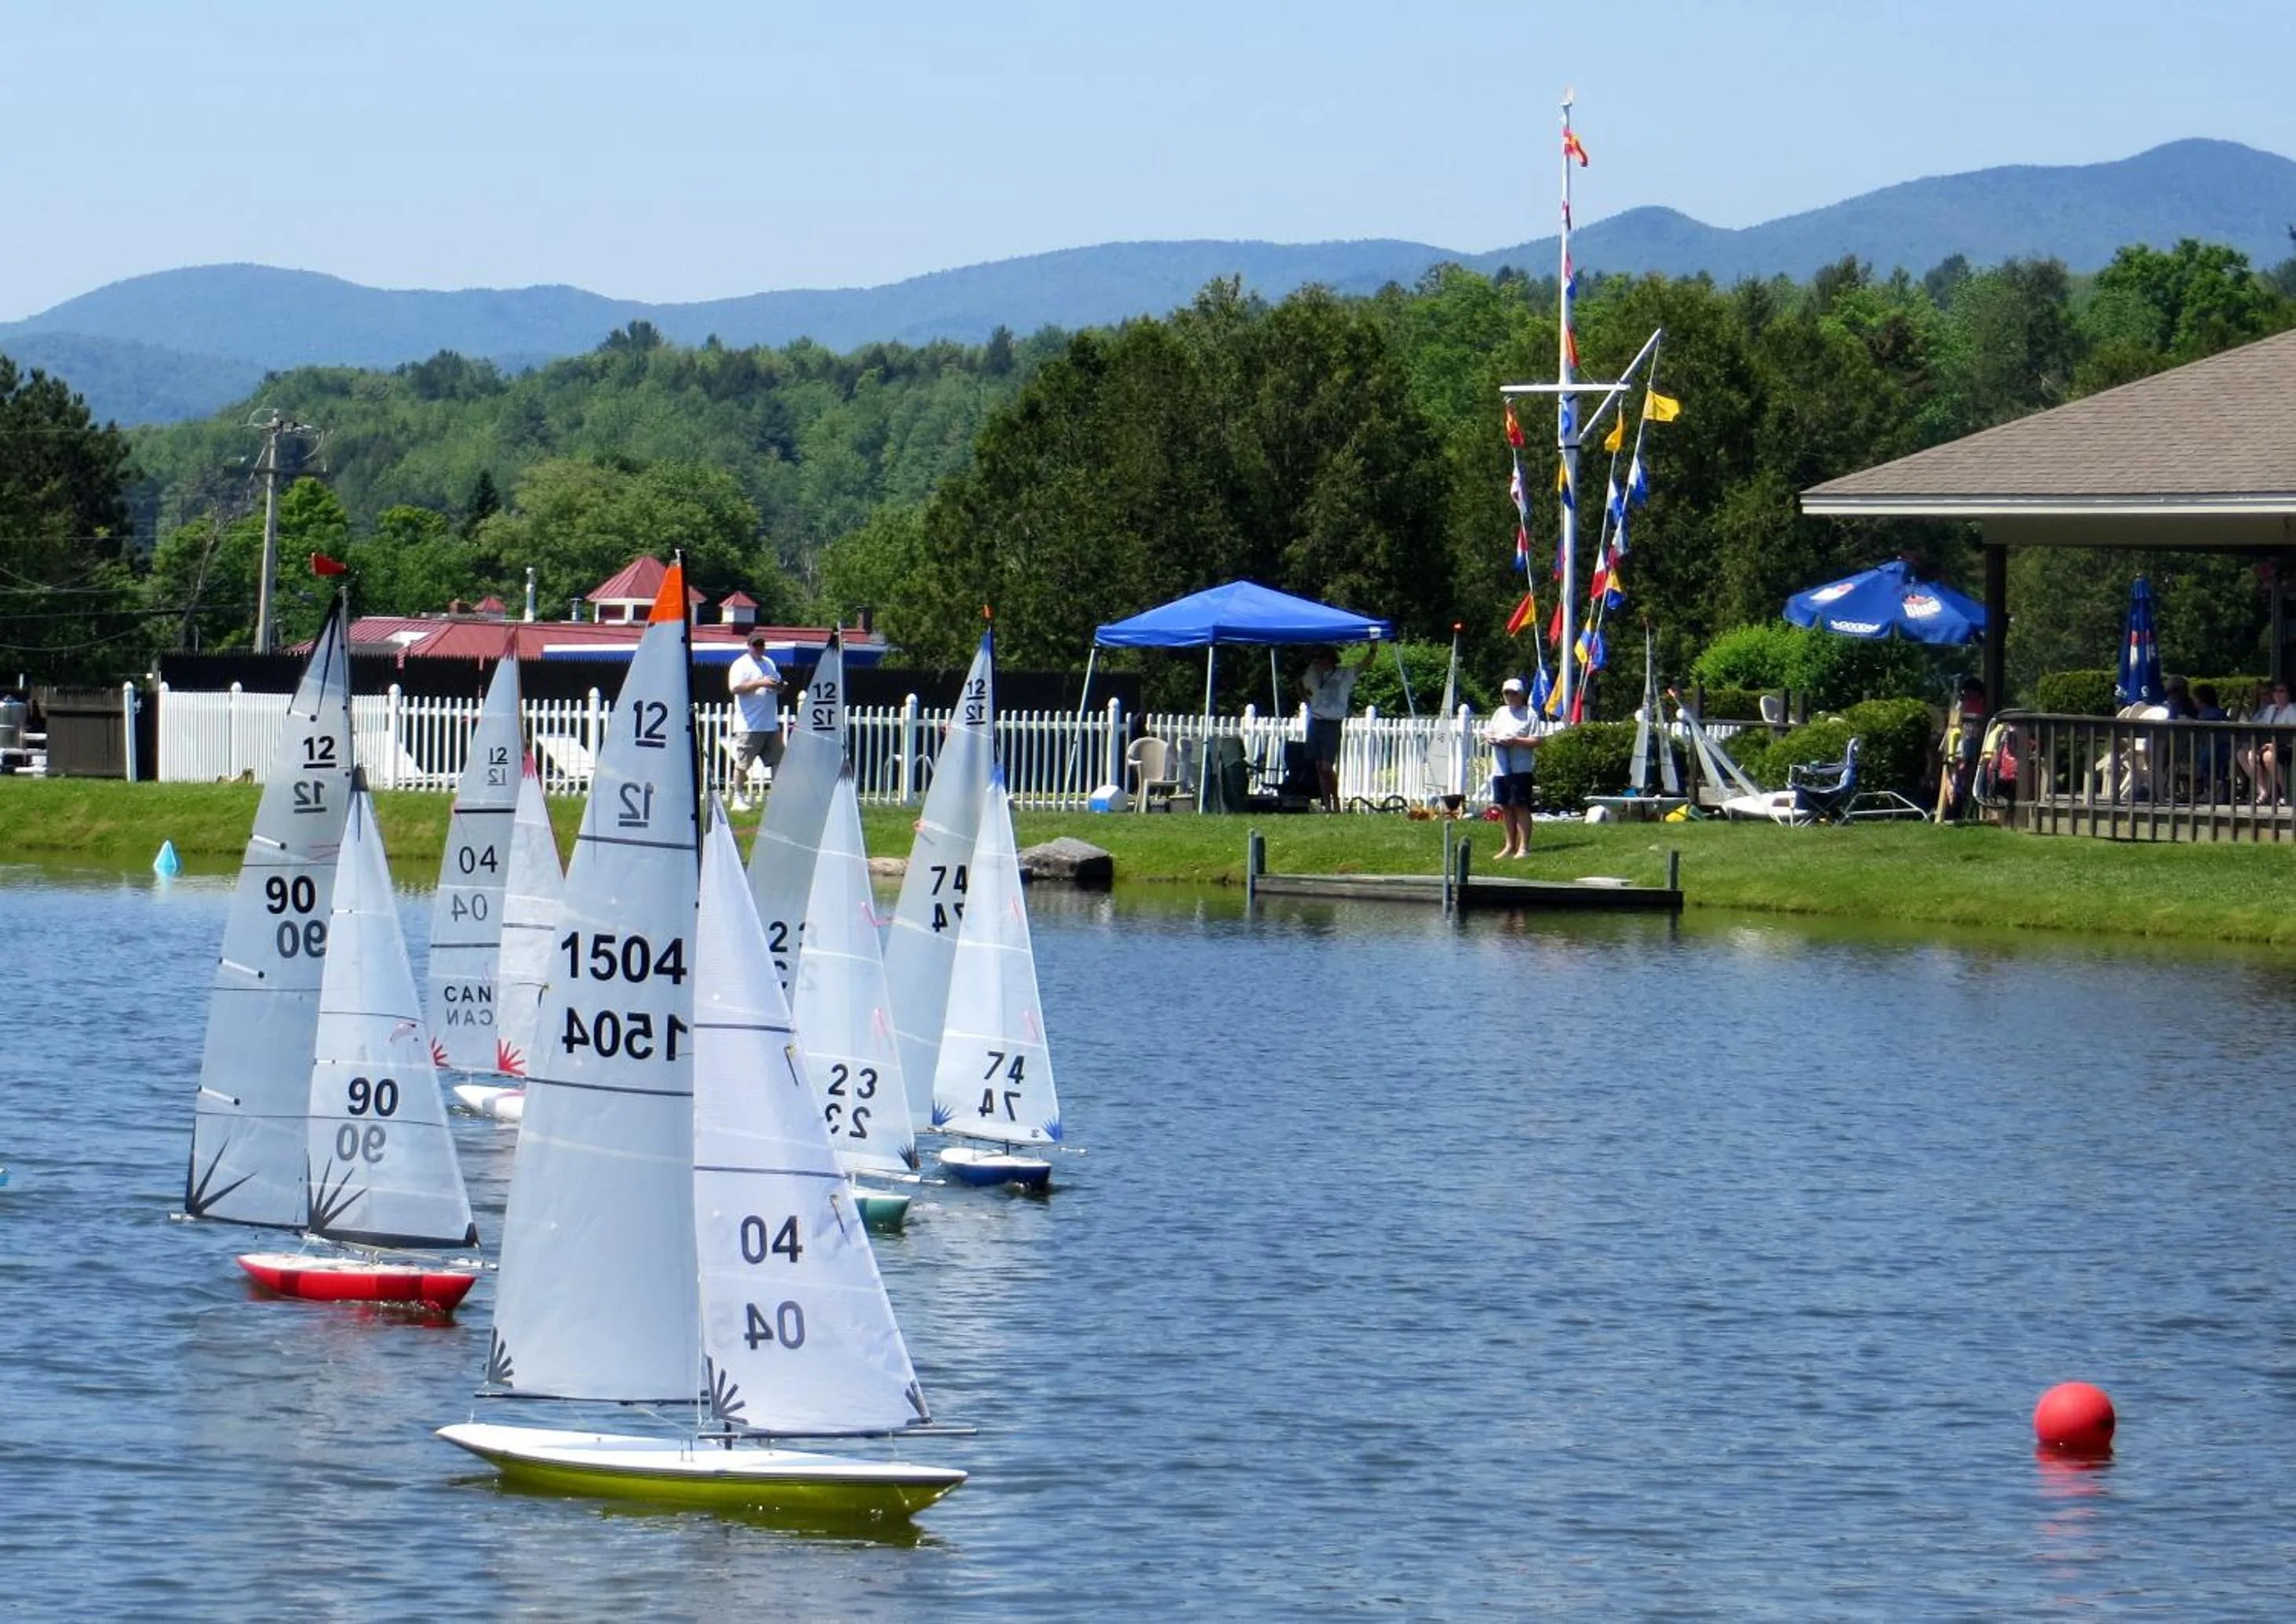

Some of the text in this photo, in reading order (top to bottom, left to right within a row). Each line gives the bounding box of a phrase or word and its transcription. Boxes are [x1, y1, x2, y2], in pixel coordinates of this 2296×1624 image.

[812, 681, 836, 699] 12
[964, 677, 986, 696] 12
[633, 700, 668, 740] 12
[303, 735, 336, 761] 12
[489, 746, 508, 763] 12
[459, 845, 498, 875] 04
[265, 875, 315, 915] 90
[931, 865, 968, 896] 74
[561, 931, 687, 985] 1504
[444, 985, 492, 1003] CAN
[828, 1063, 878, 1099] 23
[984, 1051, 1025, 1085] 74
[348, 1077, 399, 1117] 90
[740, 1215, 803, 1265] 04
